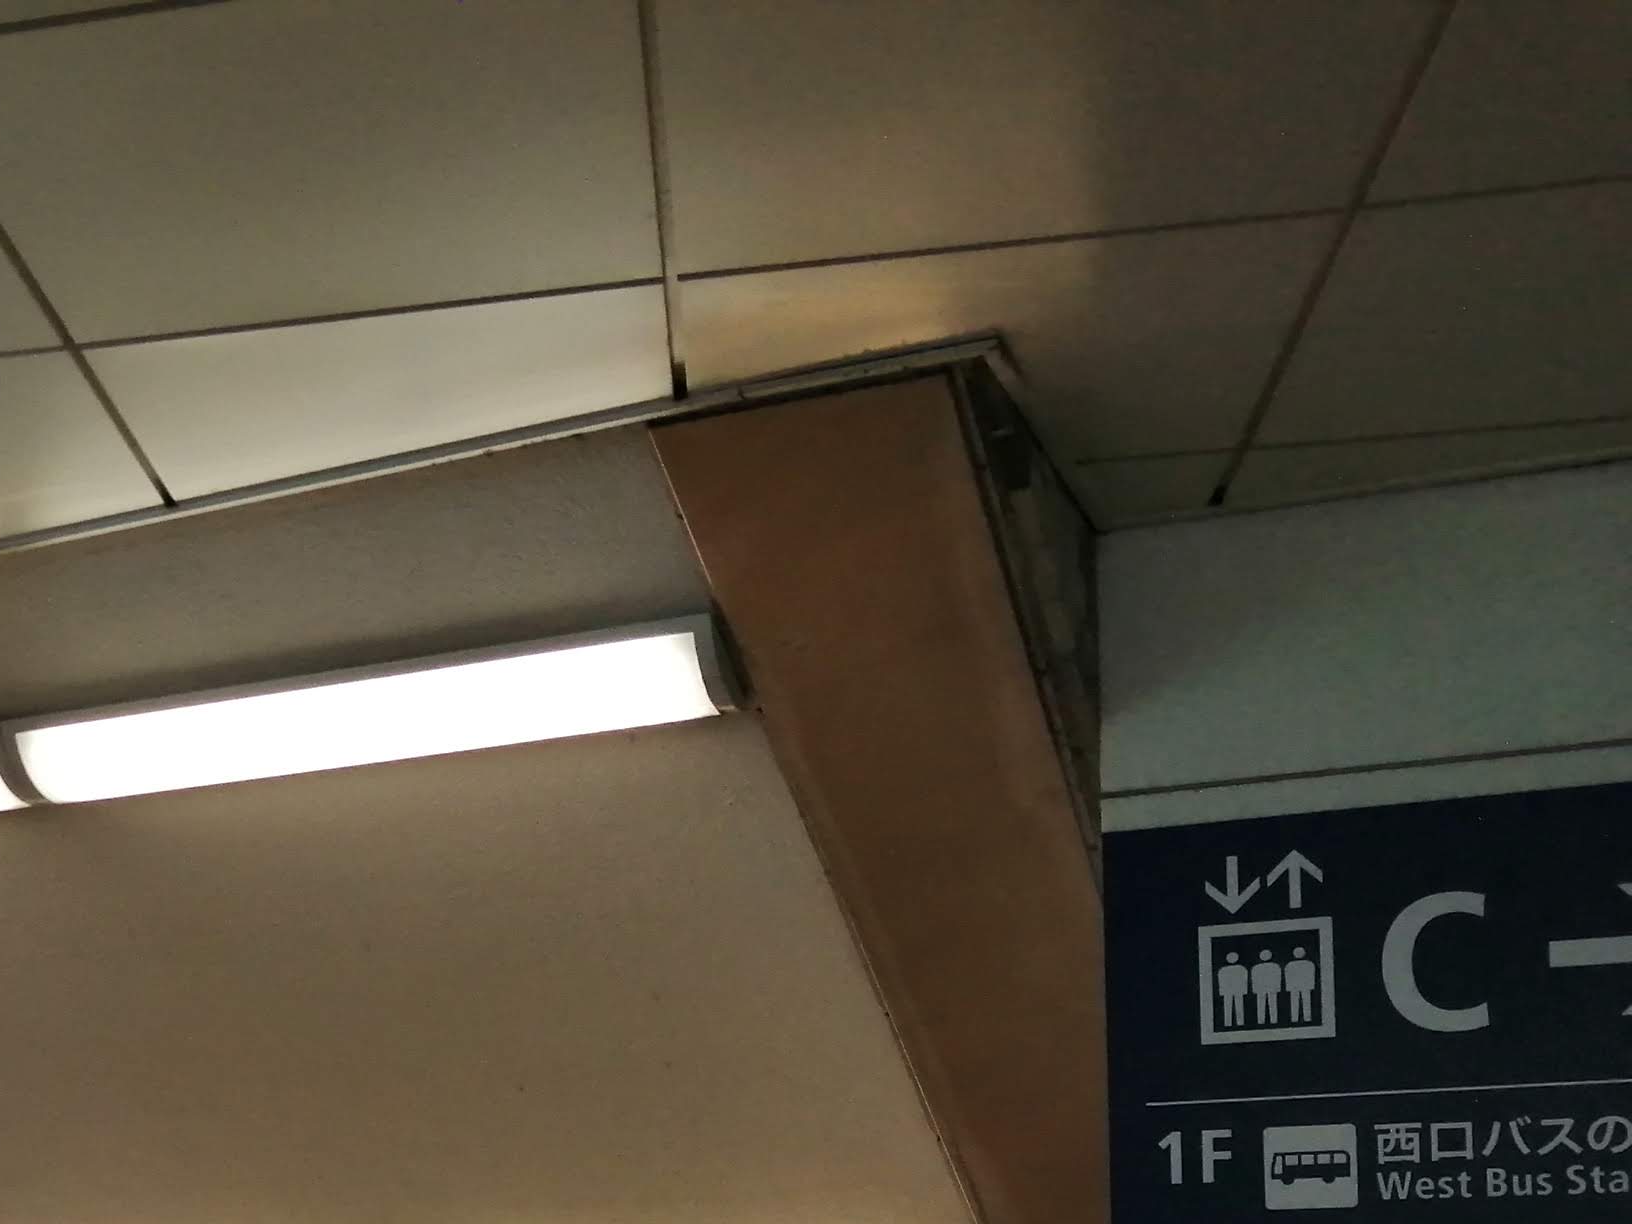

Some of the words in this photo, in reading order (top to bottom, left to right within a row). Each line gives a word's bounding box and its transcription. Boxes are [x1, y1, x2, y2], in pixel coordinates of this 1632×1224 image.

[1381, 890, 1490, 1032] C
[1158, 1128, 1233, 1185] 1F
[1374, 1115, 1632, 1164] 西口バスの
[1376, 1170, 1472, 1200] West
[1486, 1167, 1552, 1197] Bus
[1566, 1164, 1630, 1195] Sta
